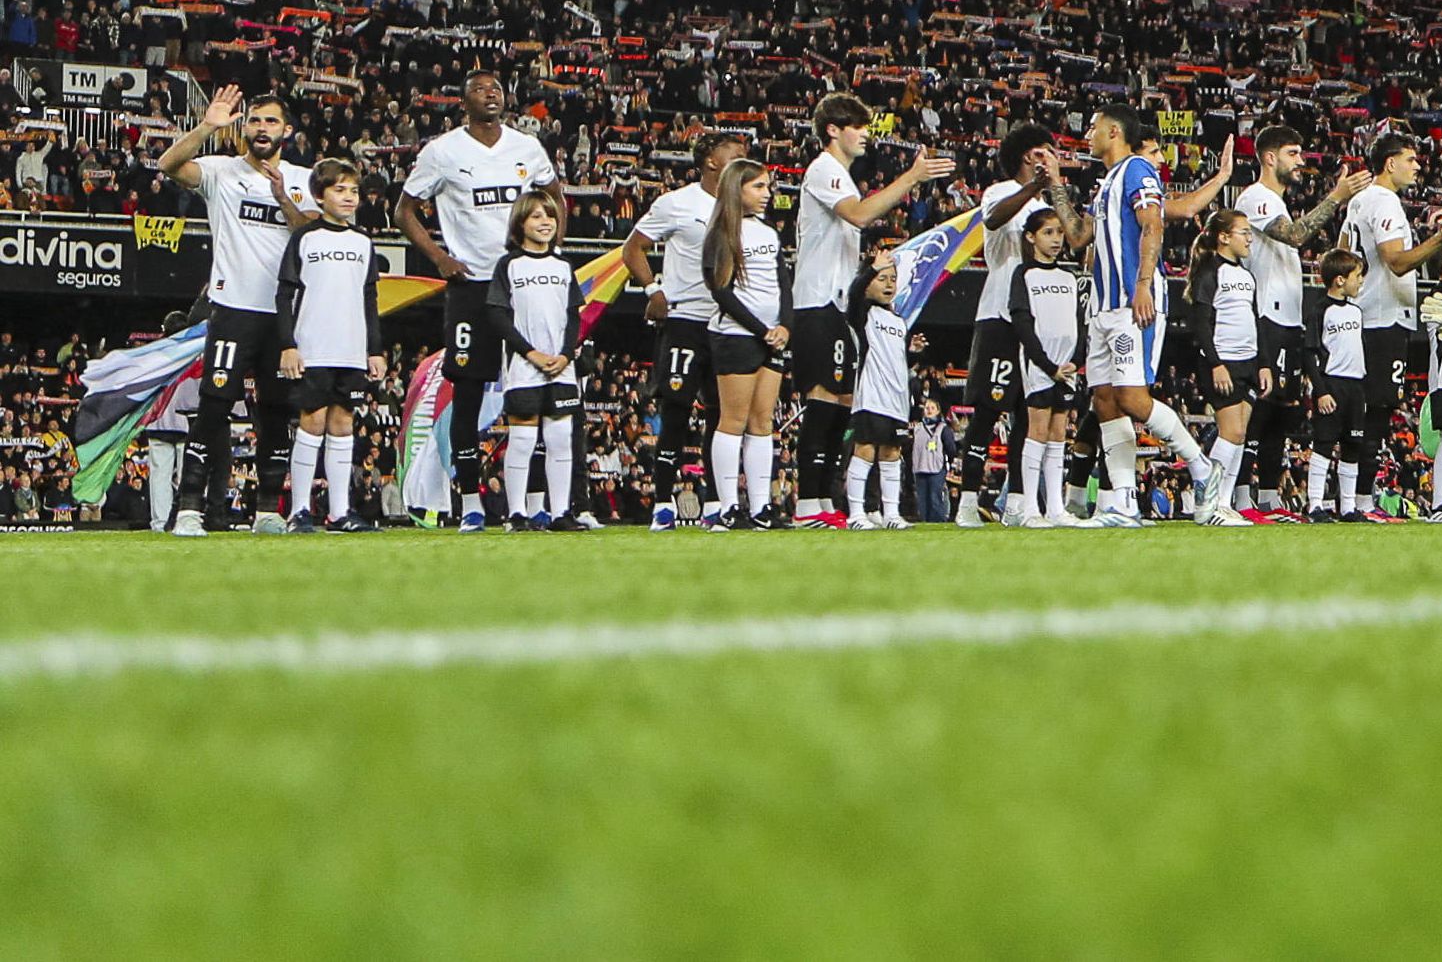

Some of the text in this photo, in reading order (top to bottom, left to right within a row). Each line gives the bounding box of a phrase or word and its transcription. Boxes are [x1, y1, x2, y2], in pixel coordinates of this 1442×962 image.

[69, 71, 96, 87] TM
[475, 190, 496, 204] TM
[145, 218, 175, 230] LIM
[243, 205, 264, 219] TM
[0, 229, 123, 271] divina
[57, 271, 121, 288] seguros
[455, 322, 472, 349] 6
[214, 339, 237, 370] 11
[669, 347, 695, 375] 17
[833, 339, 845, 365] 8
[990, 358, 1013, 385] 12
